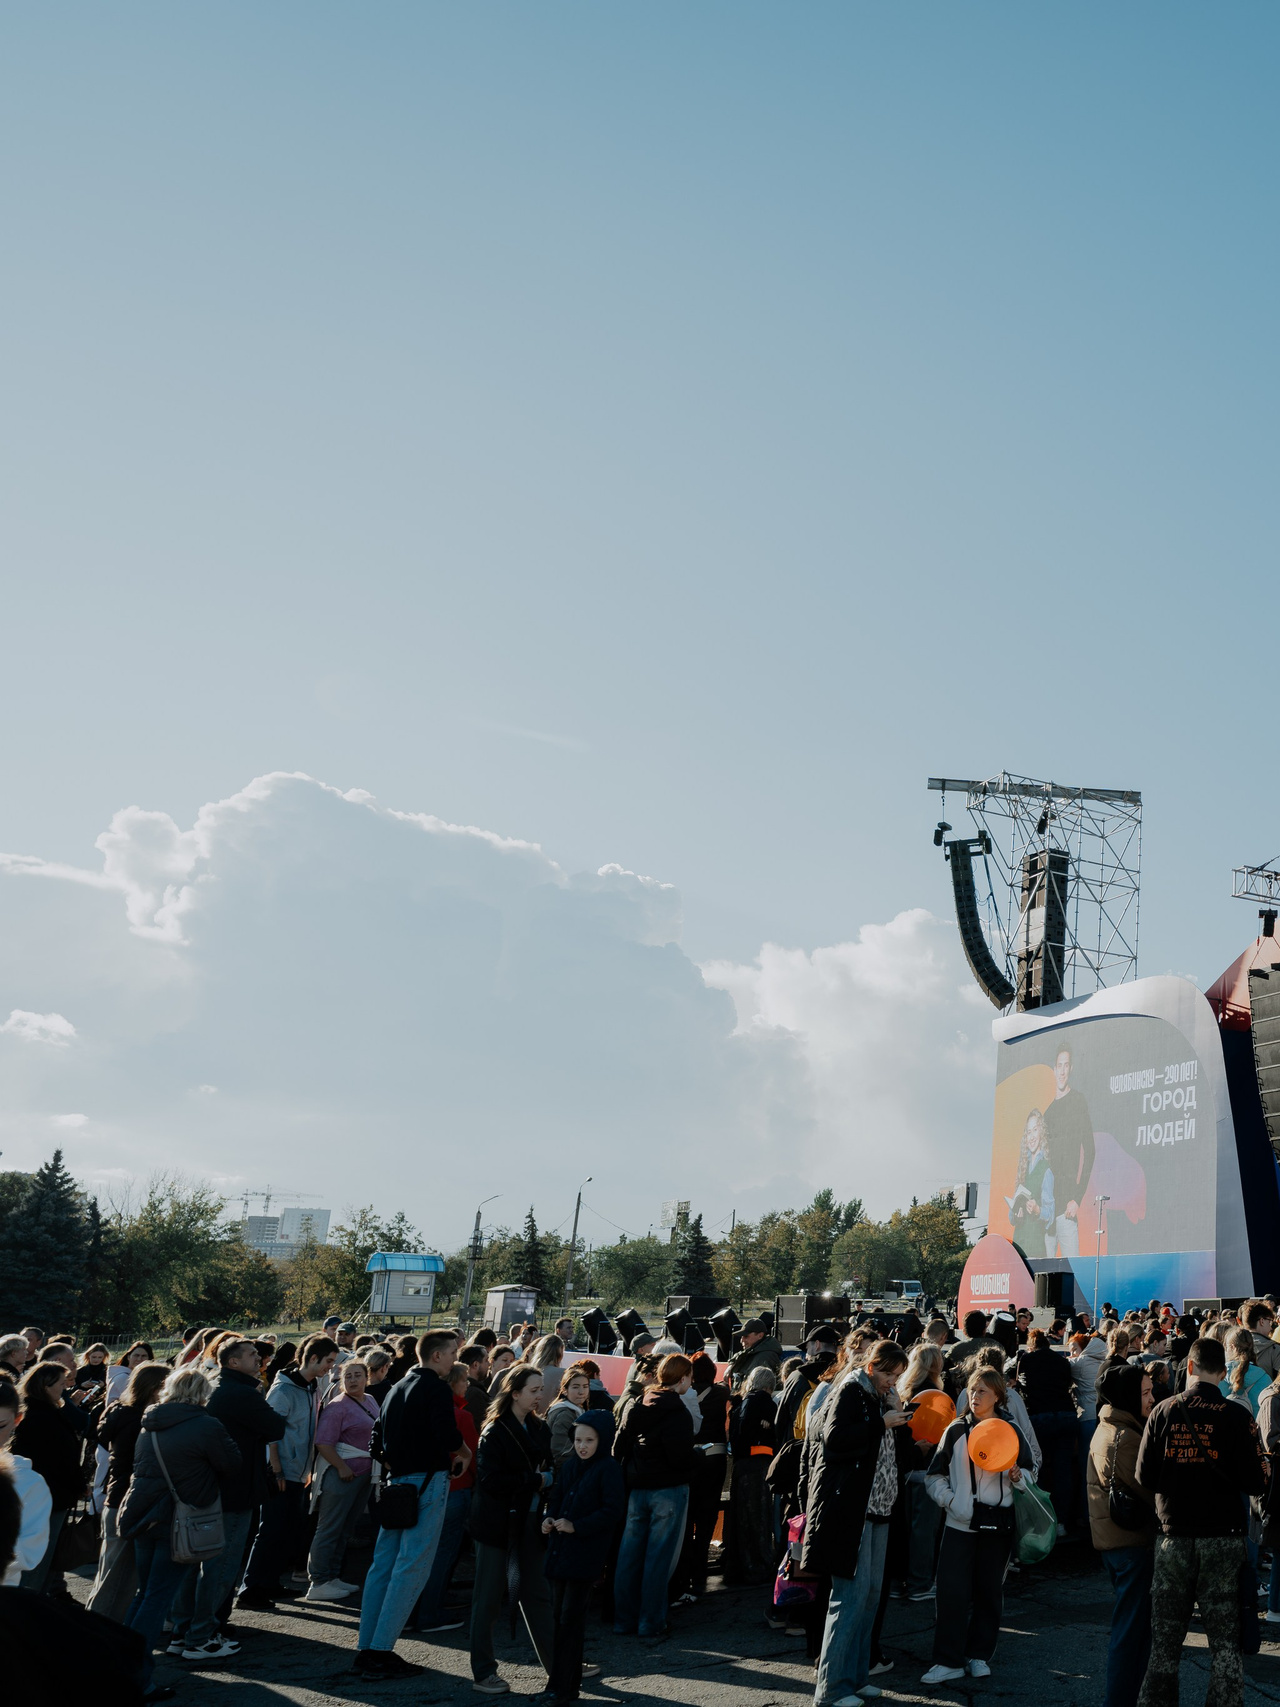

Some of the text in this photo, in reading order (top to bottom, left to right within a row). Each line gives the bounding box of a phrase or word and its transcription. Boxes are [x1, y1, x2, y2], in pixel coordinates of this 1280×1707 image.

[1164, 1063, 1180, 1085] 290
[1143, 1085, 1197, 1114] ГОРОД
[1136, 1112, 1196, 1147] ЛЮДЕЙ
[1170, 1424, 1180, 1432] AF
[1204, 1424, 1214, 1434] 75
[1177, 1447, 1198, 1458] 2107
